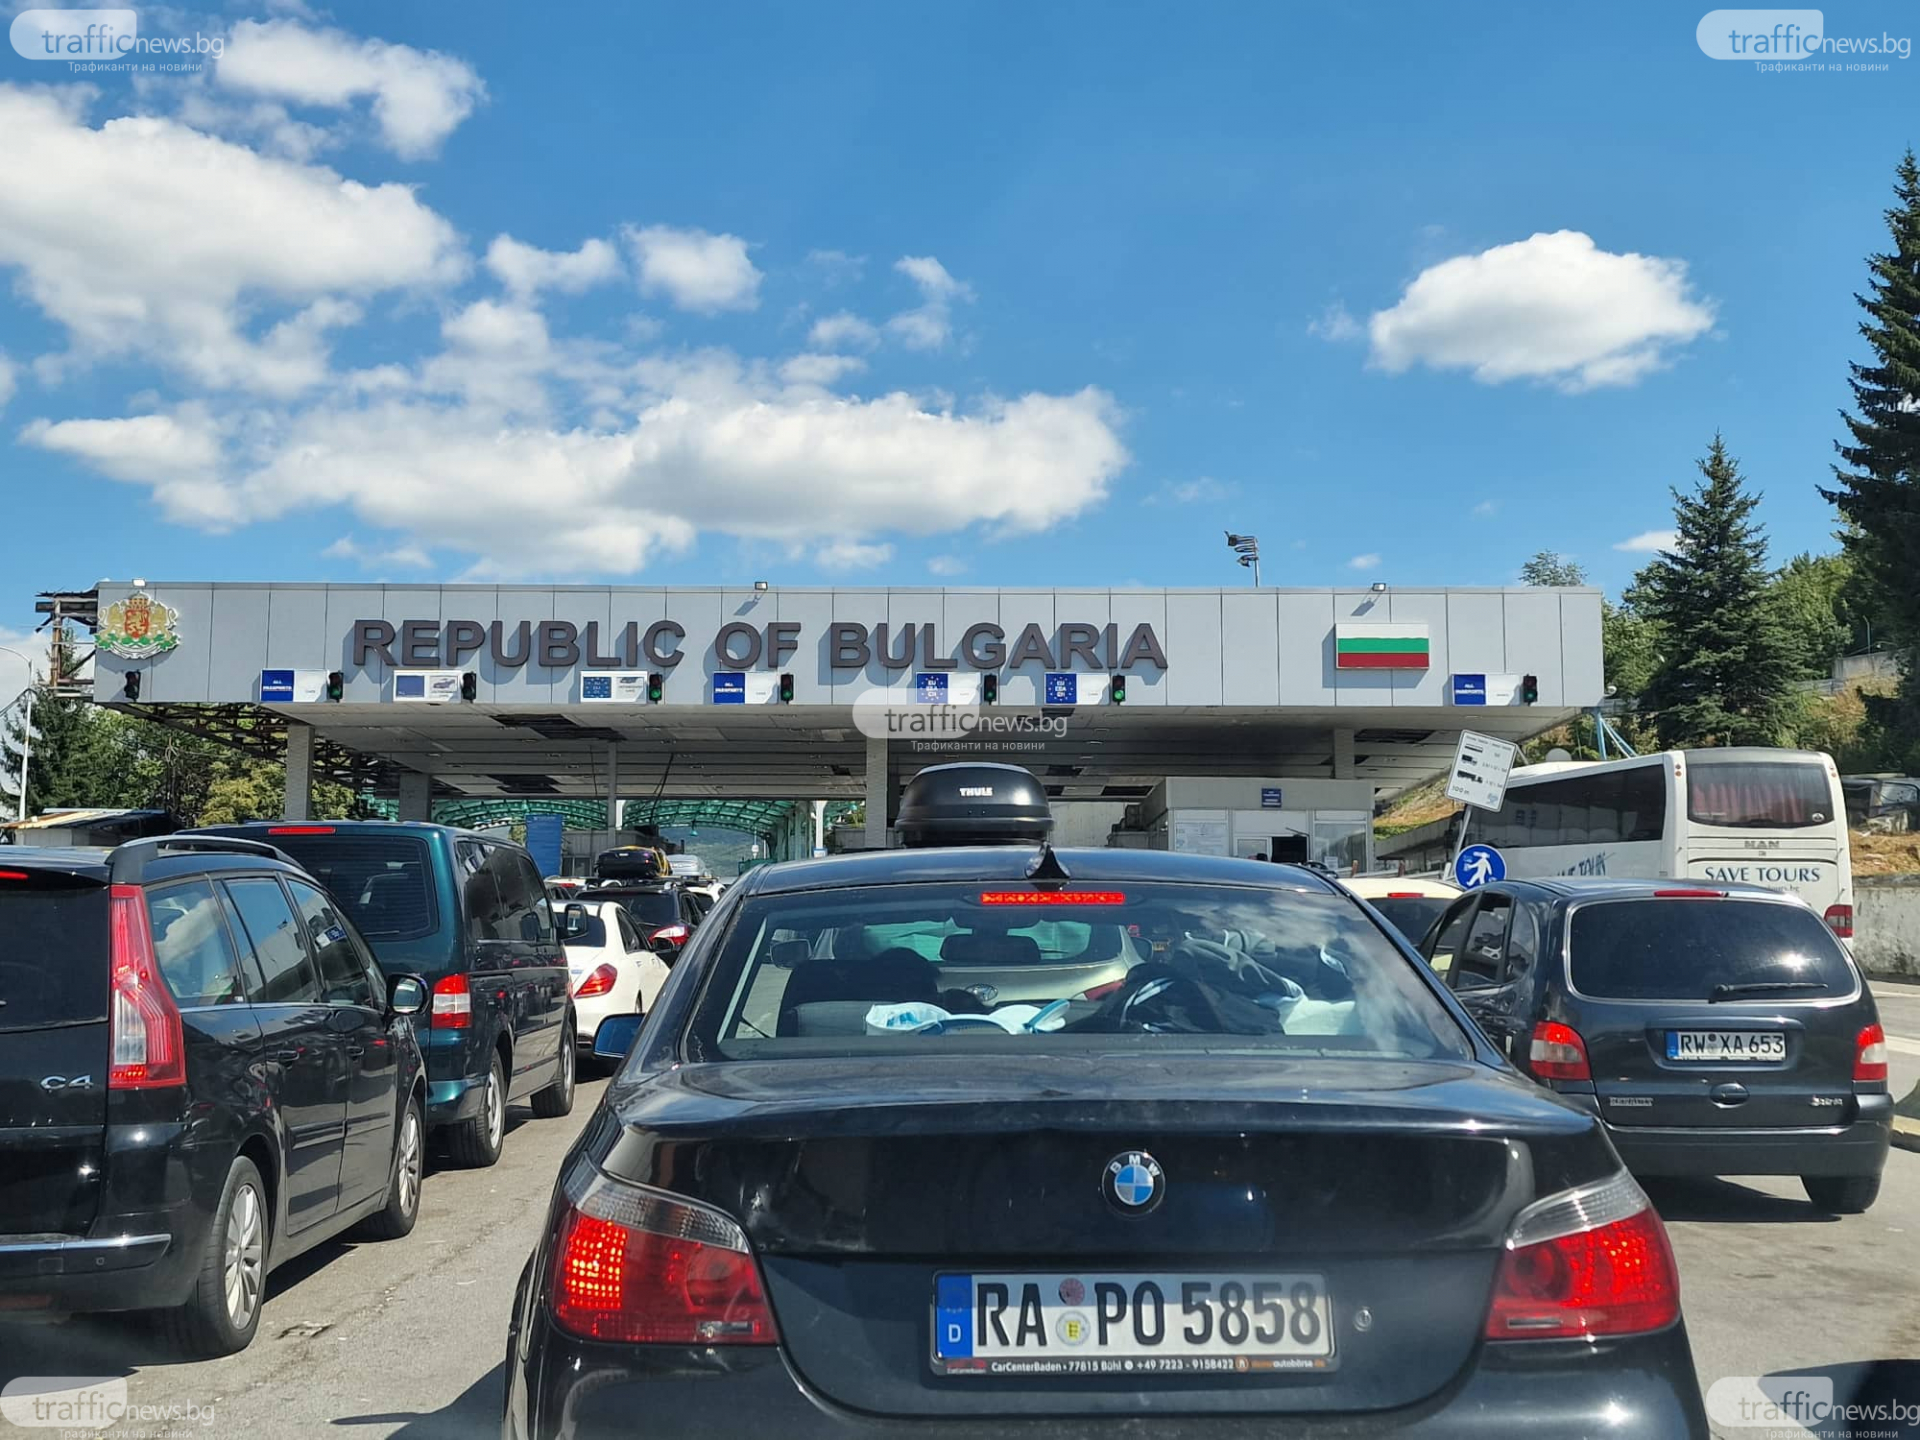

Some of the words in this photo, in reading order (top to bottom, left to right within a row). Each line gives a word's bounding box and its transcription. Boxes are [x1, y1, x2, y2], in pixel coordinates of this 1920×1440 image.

[353, 619, 686, 667] REPUBLIC
[714, 621, 801, 669] OF
[830, 621, 1168, 669] BULGARIA
[959, 787, 993, 797] THULE
[1744, 841, 1779, 849] MAN
[1705, 867, 1750, 882] SAVE
[1755, 867, 1821, 882] TOURS
[1681, 1034, 1706, 1053] RW
[1720, 1034, 1744, 1053] XA
[1748, 1034, 1784, 1053] 653
[40, 1074, 94, 1091] C4
[1109, 1153, 1161, 1177] BMW
[947, 1323, 961, 1343] D
[976, 1282, 1048, 1347] RA
[1094, 1281, 1166, 1346] PO
[1181, 1281, 1322, 1346] 5858
[991, 1361, 1062, 1372] CarCenterBaden
[1068, 1360, 1099, 1372] 77815
[1137, 1359, 1157, 1370] +49
[1159, 1359, 1184, 1370] 7223
[1191, 1359, 1234, 1370] 9158422
